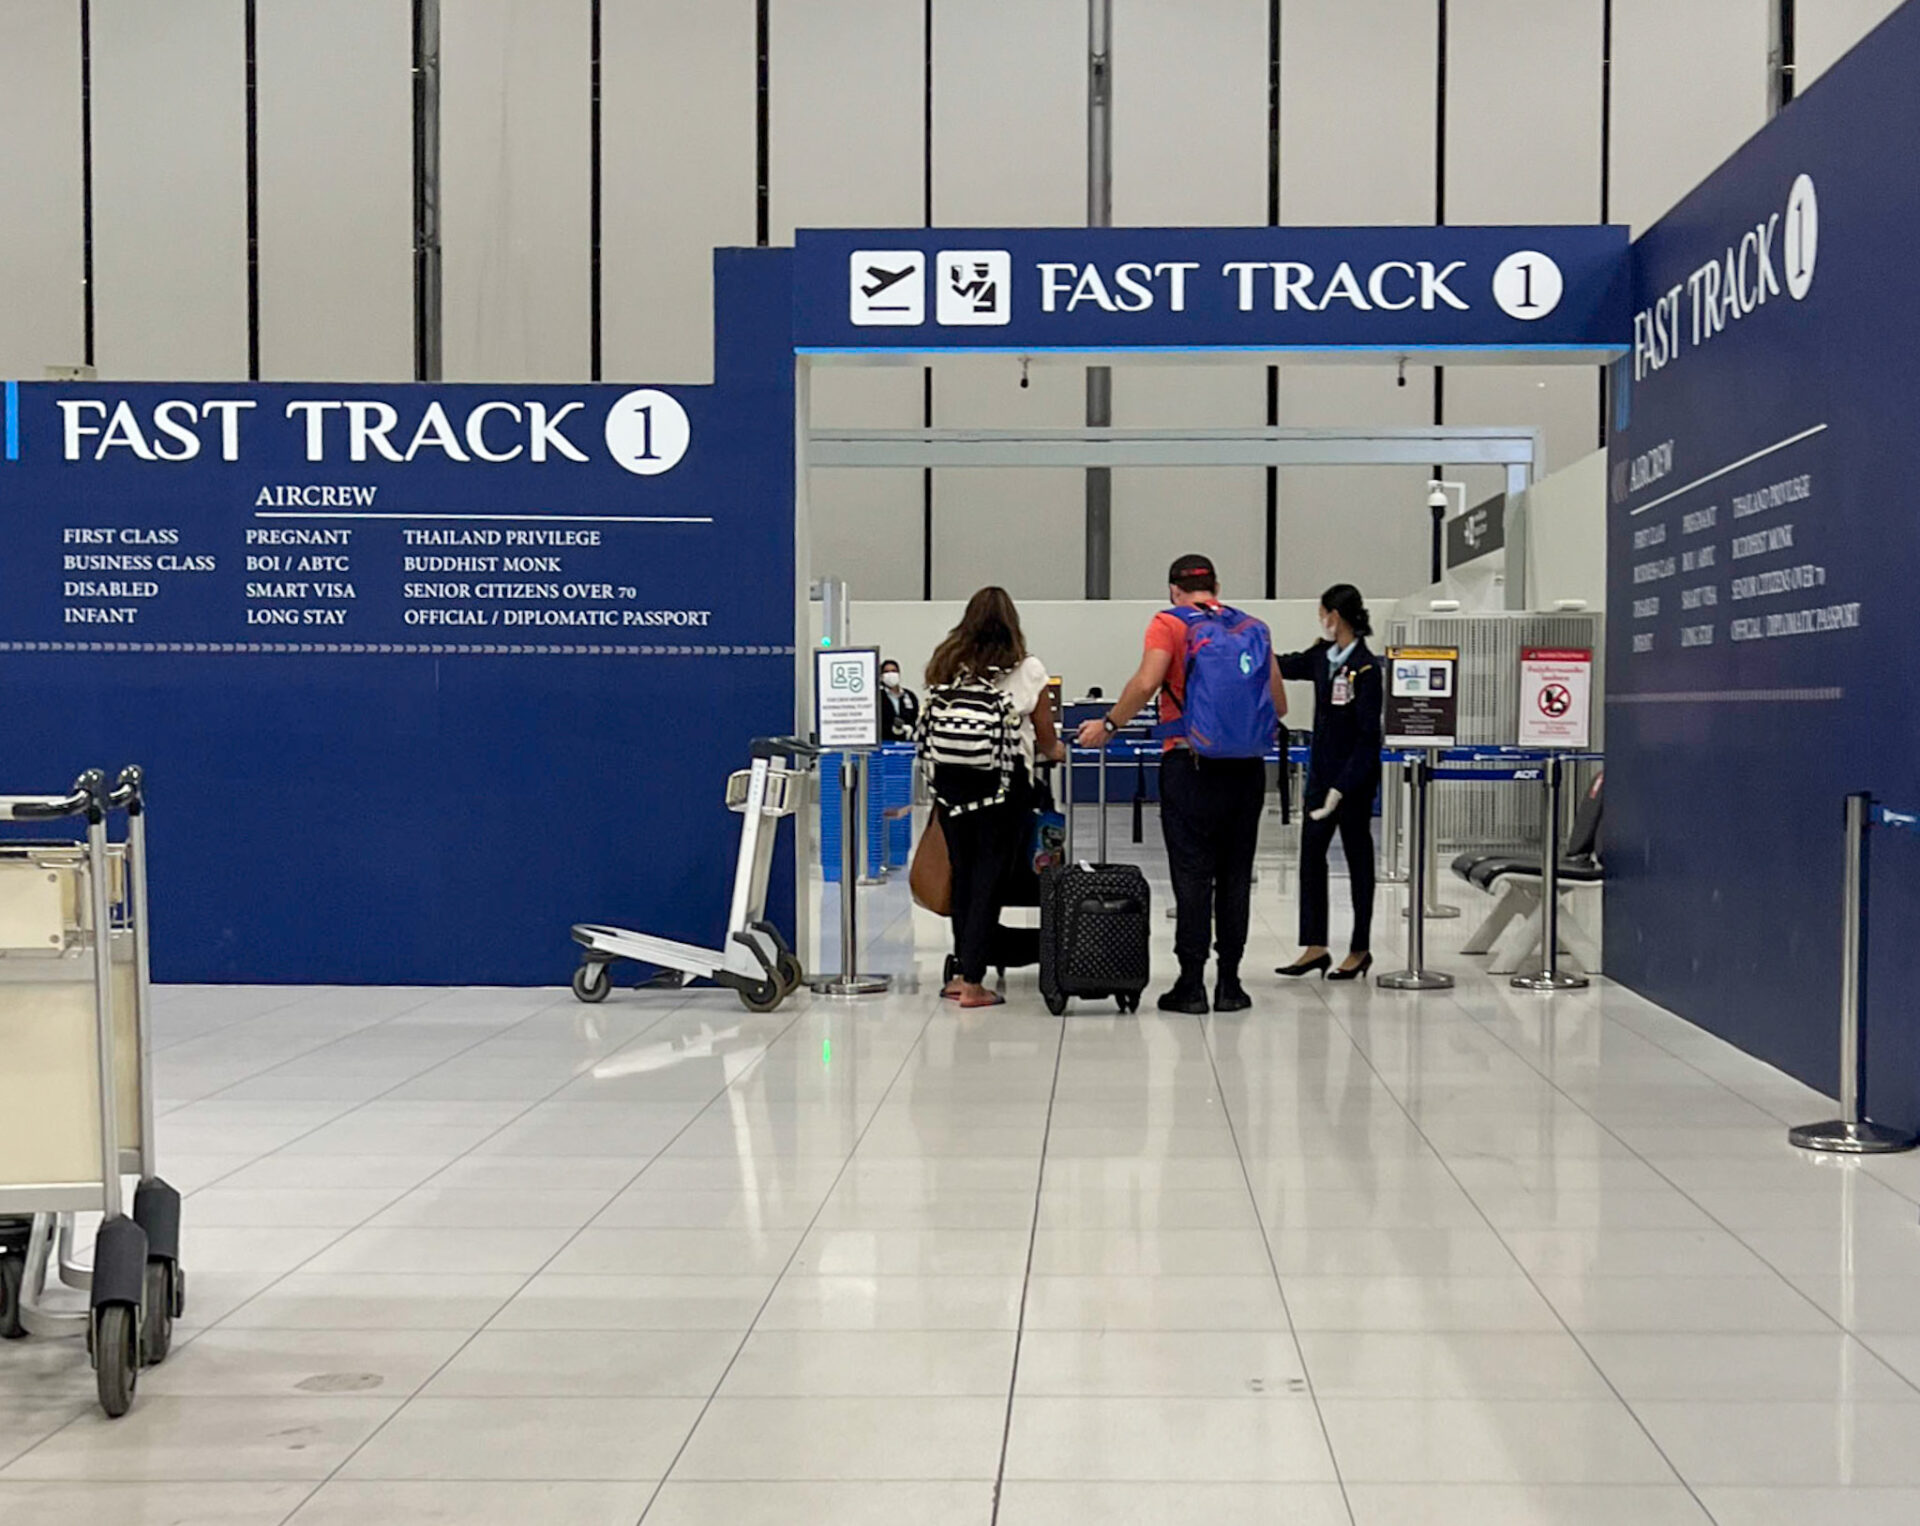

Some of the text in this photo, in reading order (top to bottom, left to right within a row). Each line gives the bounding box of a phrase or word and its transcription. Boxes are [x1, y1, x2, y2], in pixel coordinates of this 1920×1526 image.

[1036, 261, 1539, 312] FAST TRACK 1
[1634, 283, 1684, 382] FAST
[1687, 211, 1781, 347] TRACK
[56, 400, 661, 463] FAST TRACK 1
[255, 484, 377, 507] AIRCREW
[63, 528, 179, 544] FIRST CLASS
[246, 529, 352, 545] PREGNANT
[403, 529, 601, 546] THAILAND PRIVILEGE
[64, 555, 216, 571] BUSINESS CLASS
[246, 555, 349, 572] BOI / ABTC
[404, 556, 561, 573] BUDDHIST MONK
[64, 581, 159, 597] DISABLED
[246, 582, 356, 598] SMART VISA
[404, 582, 637, 599] SENIOR CITIZENS OVER 70
[64, 607, 138, 624] INFANT
[247, 608, 347, 625] LONG STAY
[404, 609, 711, 627] OFFICIAL / DIPLOMATIC PASSPORT
